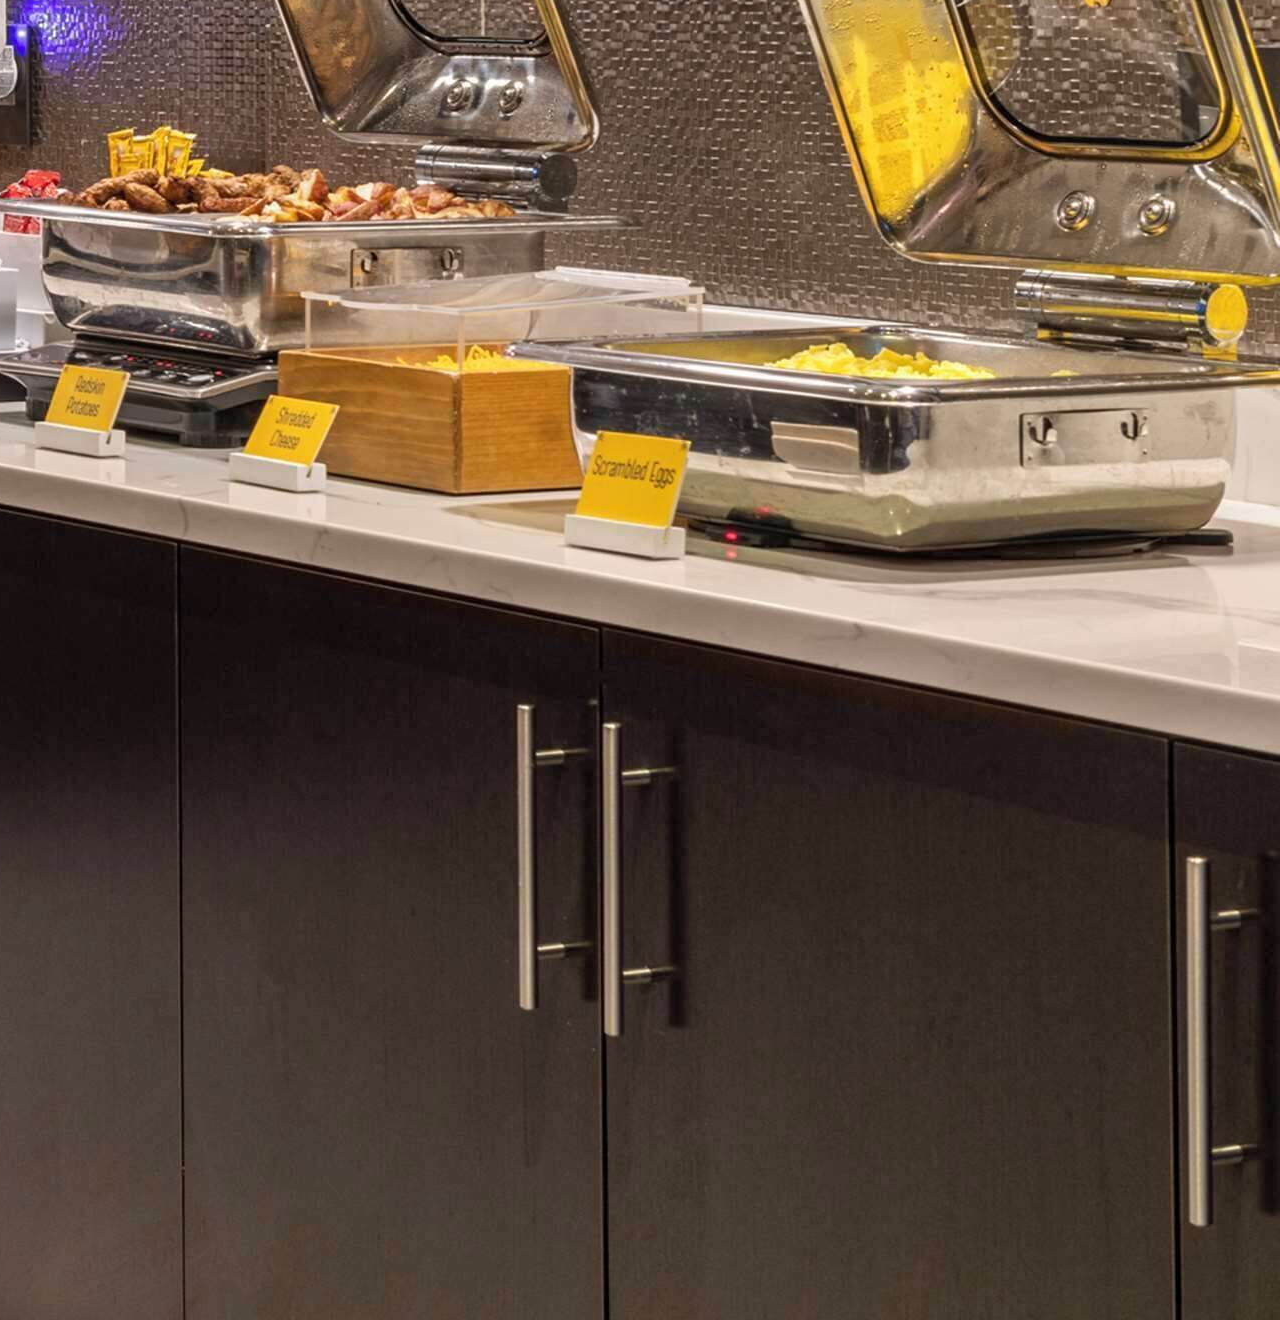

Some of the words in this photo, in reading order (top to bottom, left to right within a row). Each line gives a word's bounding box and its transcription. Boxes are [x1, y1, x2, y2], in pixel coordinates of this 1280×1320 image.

[74, 374, 106, 395] Redskin
[67, 395, 101, 417] Potatoes
[275, 406, 317, 430] Shredded
[268, 430, 301, 451] Cheese
[592, 455, 649, 481] Scrambled
[649, 461, 677, 489] Eggs
